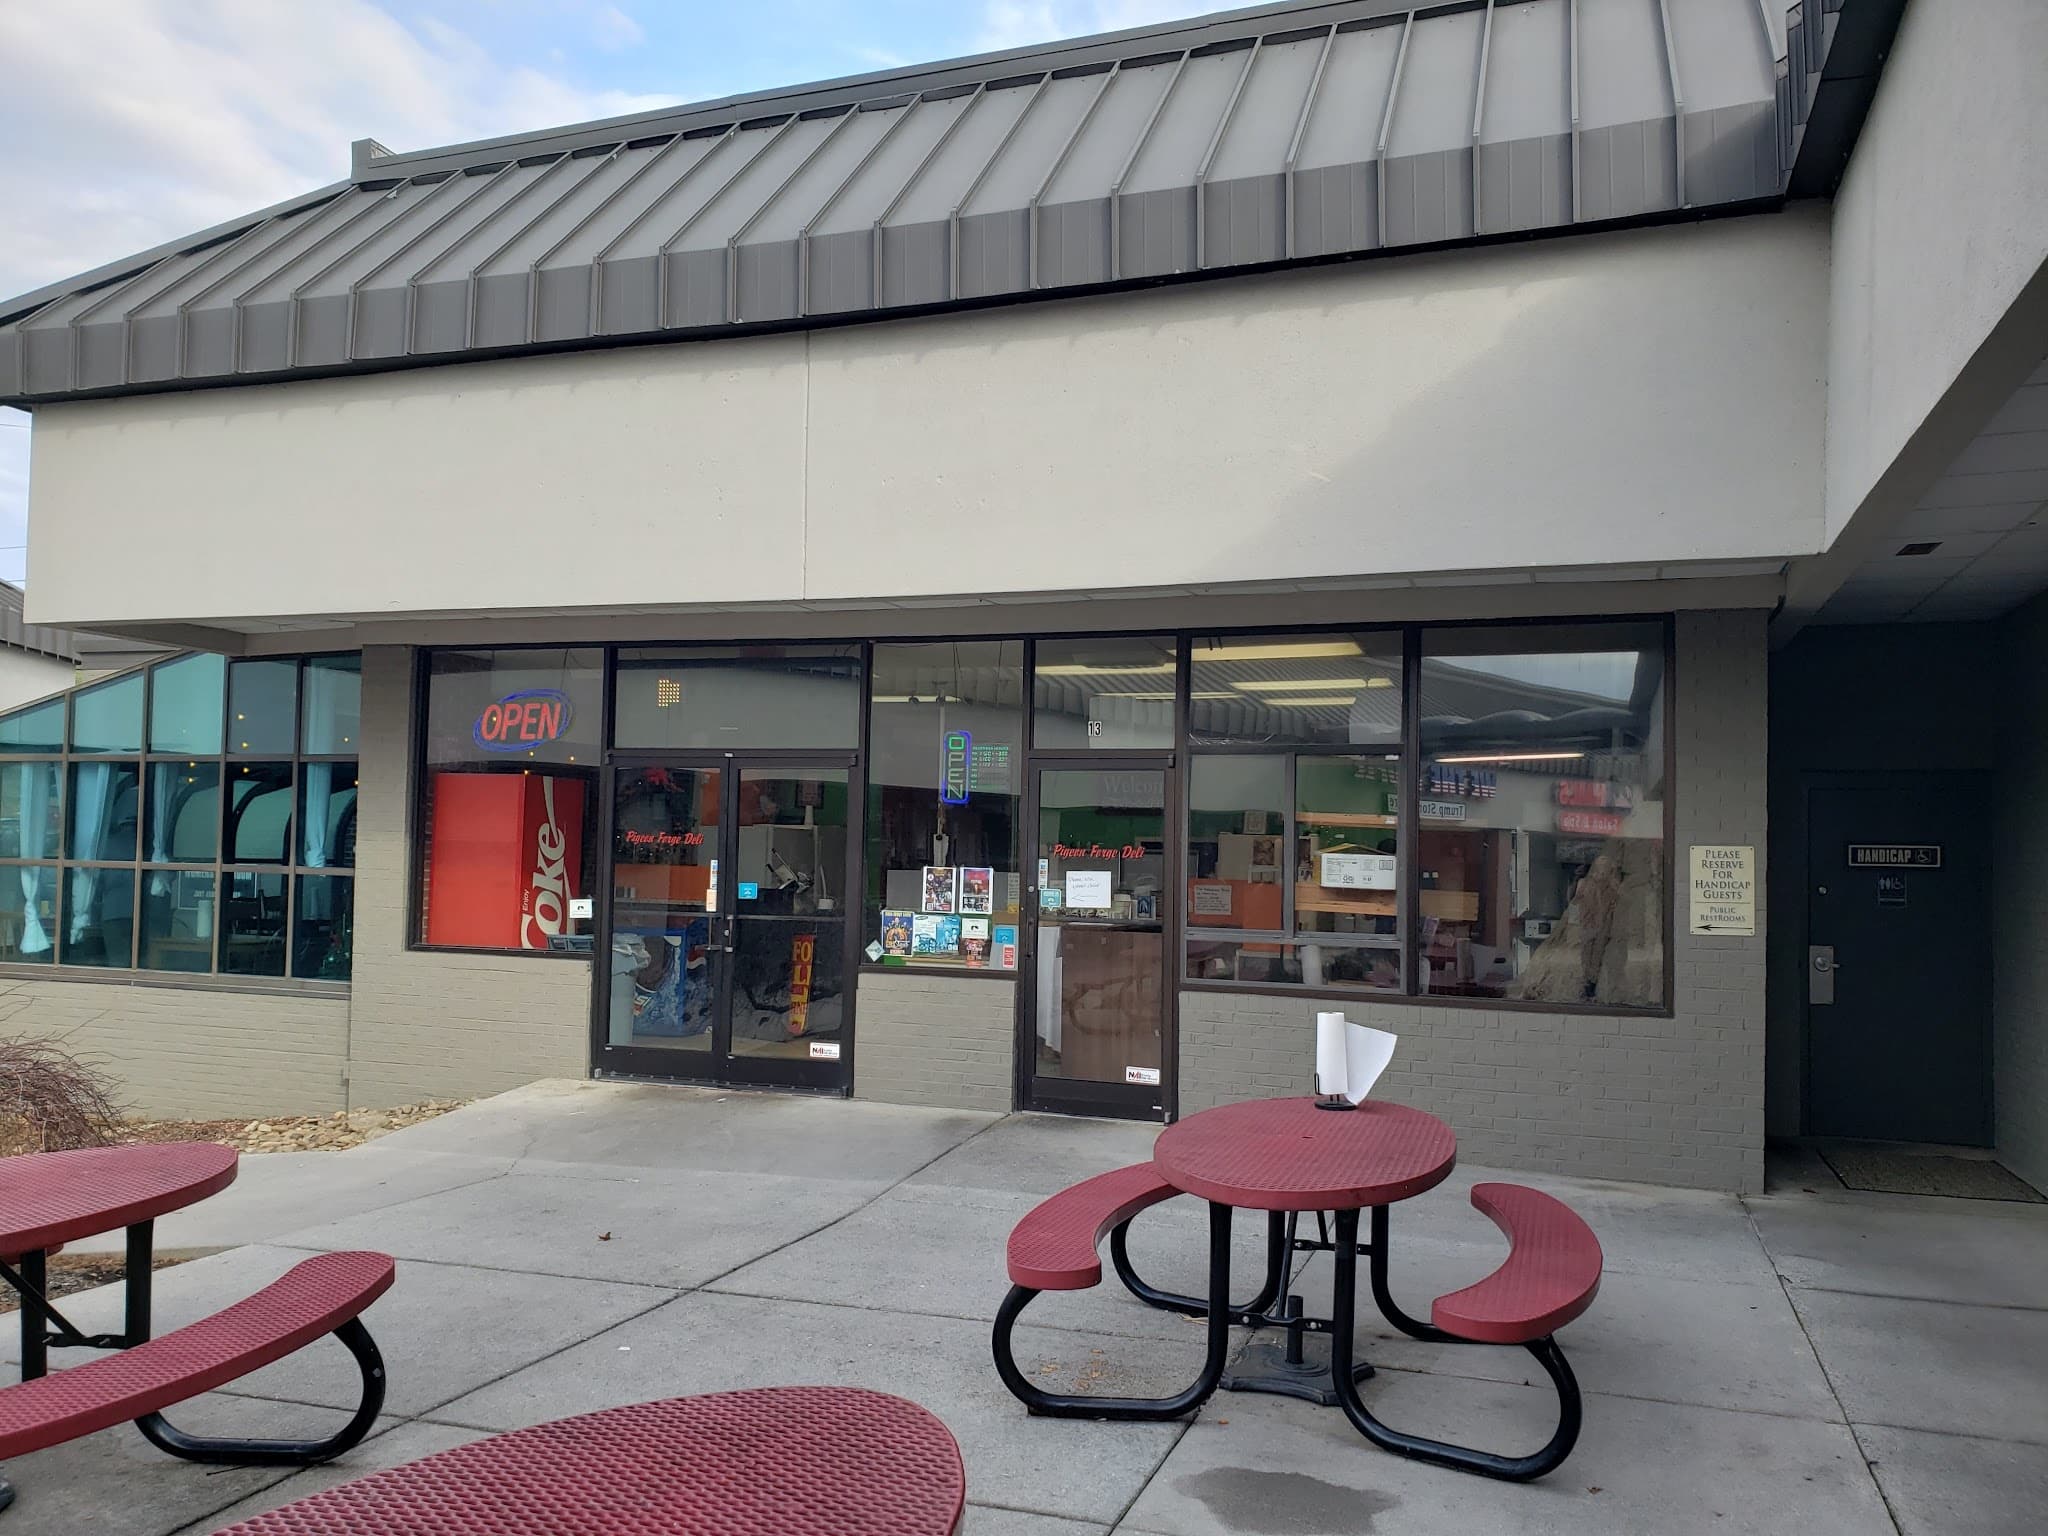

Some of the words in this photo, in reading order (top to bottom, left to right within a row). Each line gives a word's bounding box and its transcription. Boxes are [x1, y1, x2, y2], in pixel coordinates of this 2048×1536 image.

[481, 702, 561, 741] OPEN
[1089, 722, 1101, 736] 13
[947, 735, 965, 800] OPEN
[626, 831, 655, 845] Pigeon
[657, 831, 682, 846] Forge
[684, 832, 704, 845] Deli
[1053, 844, 1086, 859] Pigeon
[1089, 845, 1118, 860] Forge
[1121, 845, 1146, 858] Deli
[1705, 850, 1740, 859] PLEASE
[1857, 849, 1912, 863] HANDICAP
[1701, 860, 1744, 869] RESERVE
[1712, 869, 1733, 879] FOR
[1695, 879, 1751, 889] HANDICAP
[1703, 889, 1742, 900] GUESTS
[1709, 906, 1736, 914] PUBLIC
